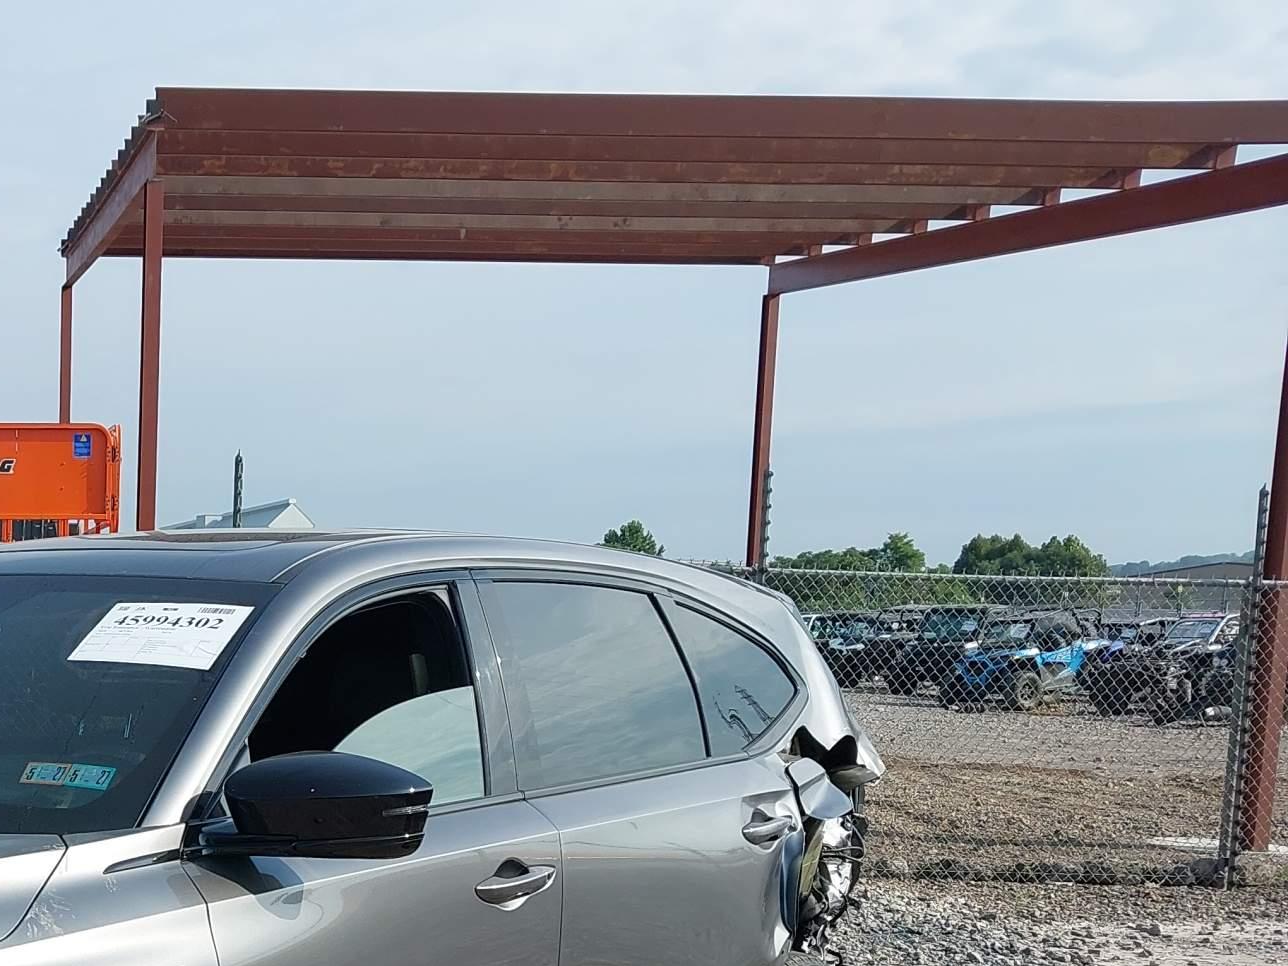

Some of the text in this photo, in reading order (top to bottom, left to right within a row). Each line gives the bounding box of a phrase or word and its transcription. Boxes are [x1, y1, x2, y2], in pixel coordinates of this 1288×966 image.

[113, 615, 224, 630] 45994302
[26, 766, 67, 782] 5 27
[70, 769, 111, 786] 5 27
